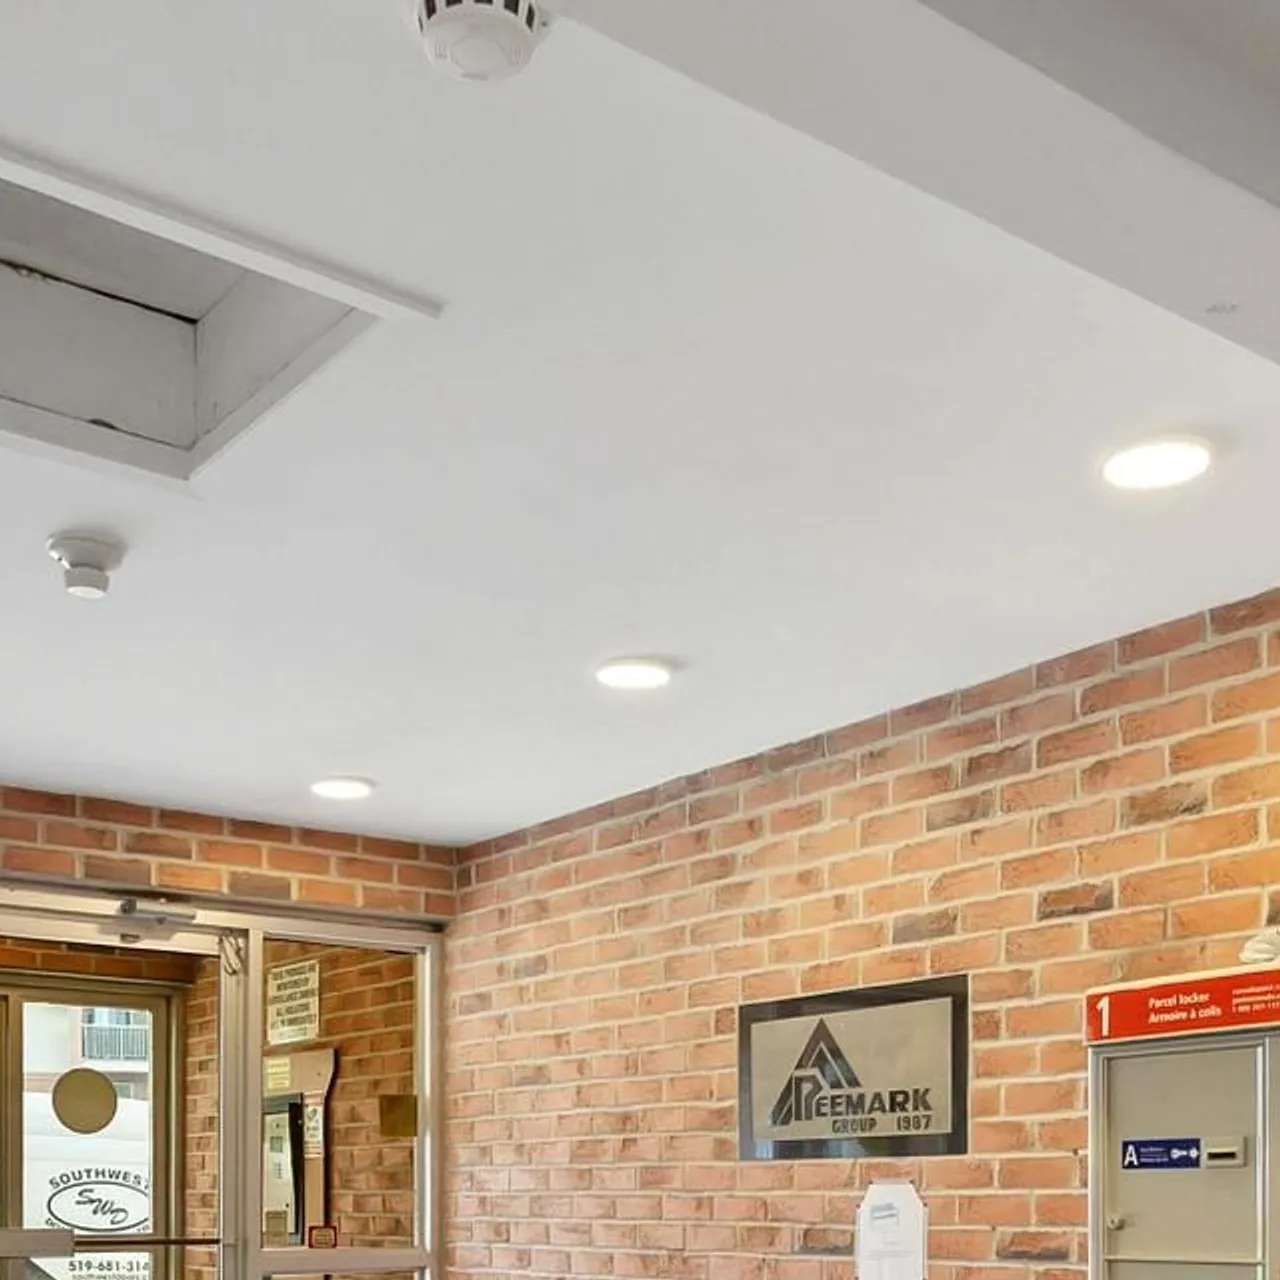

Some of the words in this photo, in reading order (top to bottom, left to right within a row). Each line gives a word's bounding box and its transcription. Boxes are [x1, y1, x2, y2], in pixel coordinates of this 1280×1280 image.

[1096, 996, 1111, 1038] 1
[832, 1118, 878, 1134] GROUP
[1124, 1144, 1138, 1167] A
